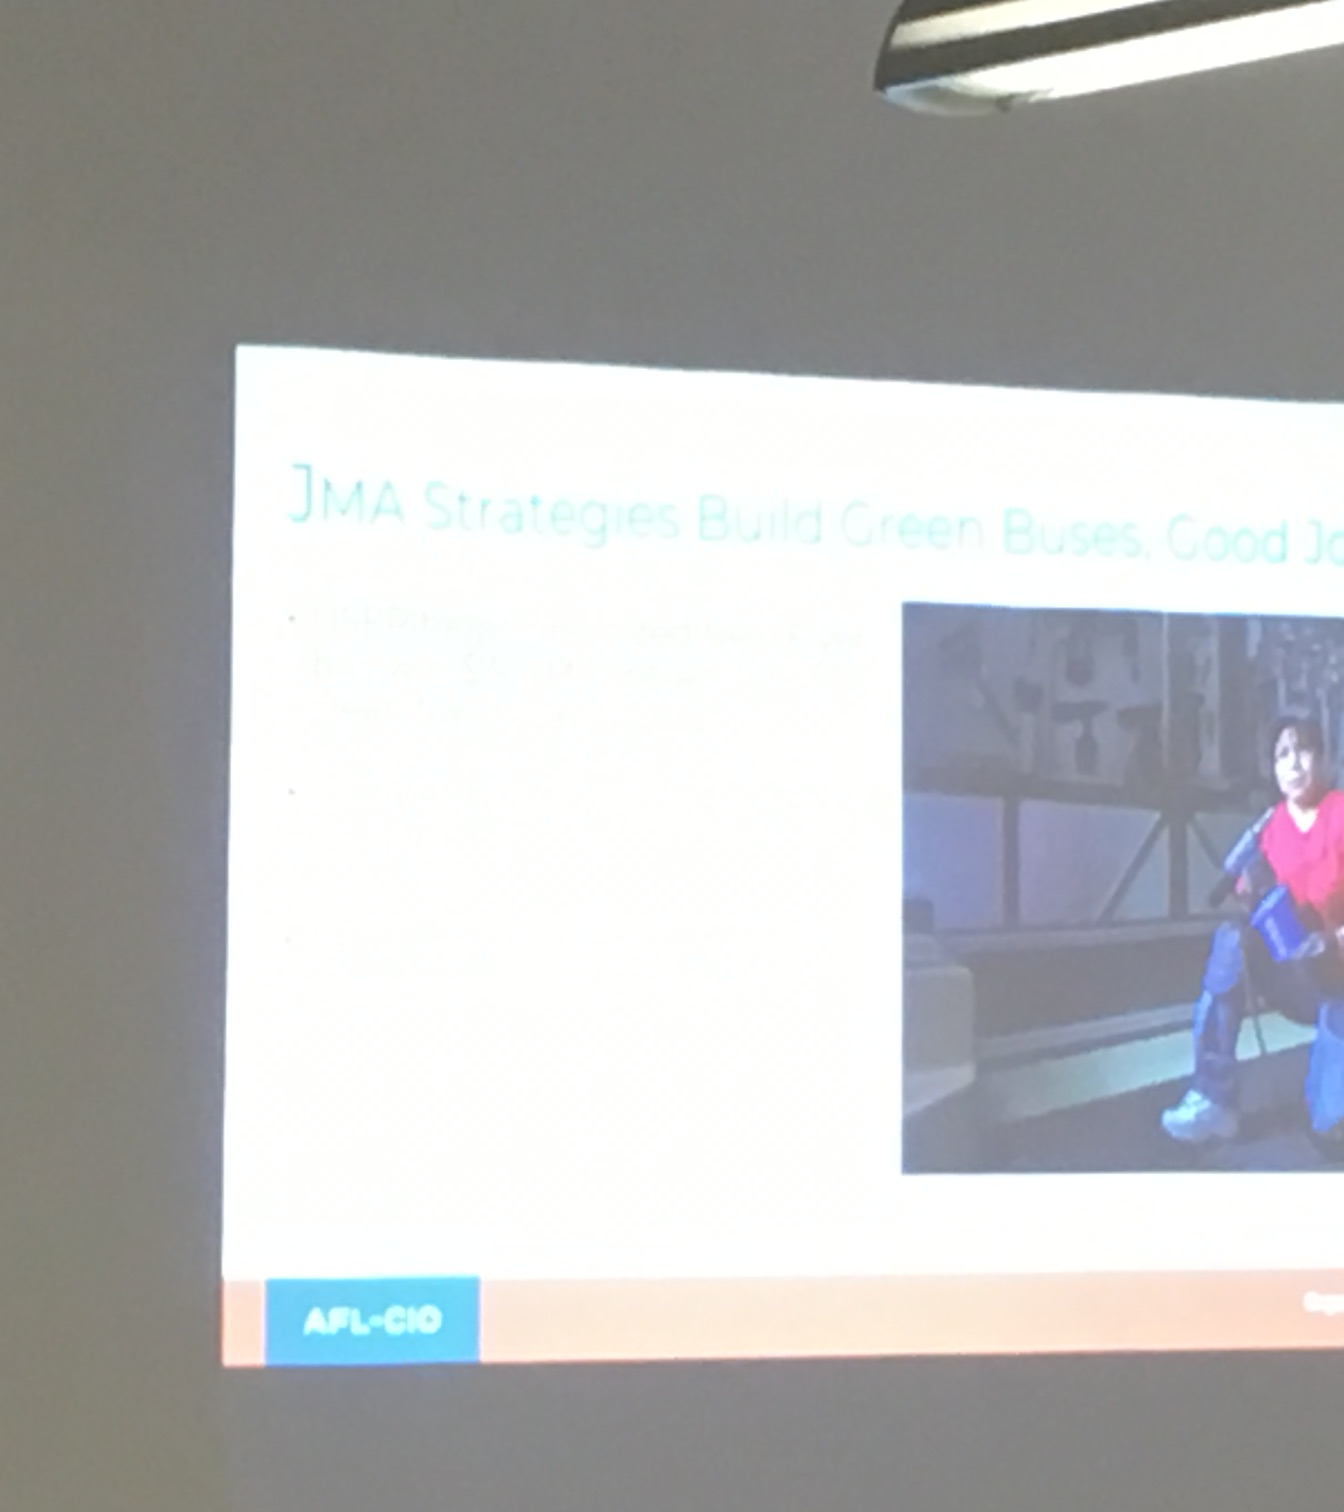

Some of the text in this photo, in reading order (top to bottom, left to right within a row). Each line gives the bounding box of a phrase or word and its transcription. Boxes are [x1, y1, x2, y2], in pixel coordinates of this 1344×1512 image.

[287, 462, 406, 524] JMA
[424, 480, 681, 549] Strategies
[698, 492, 823, 544] Build
[840, 501, 985, 549] Green
[1166, 513, 1288, 564] Good
[303, 1304, 443, 1336] AFL-CIO
